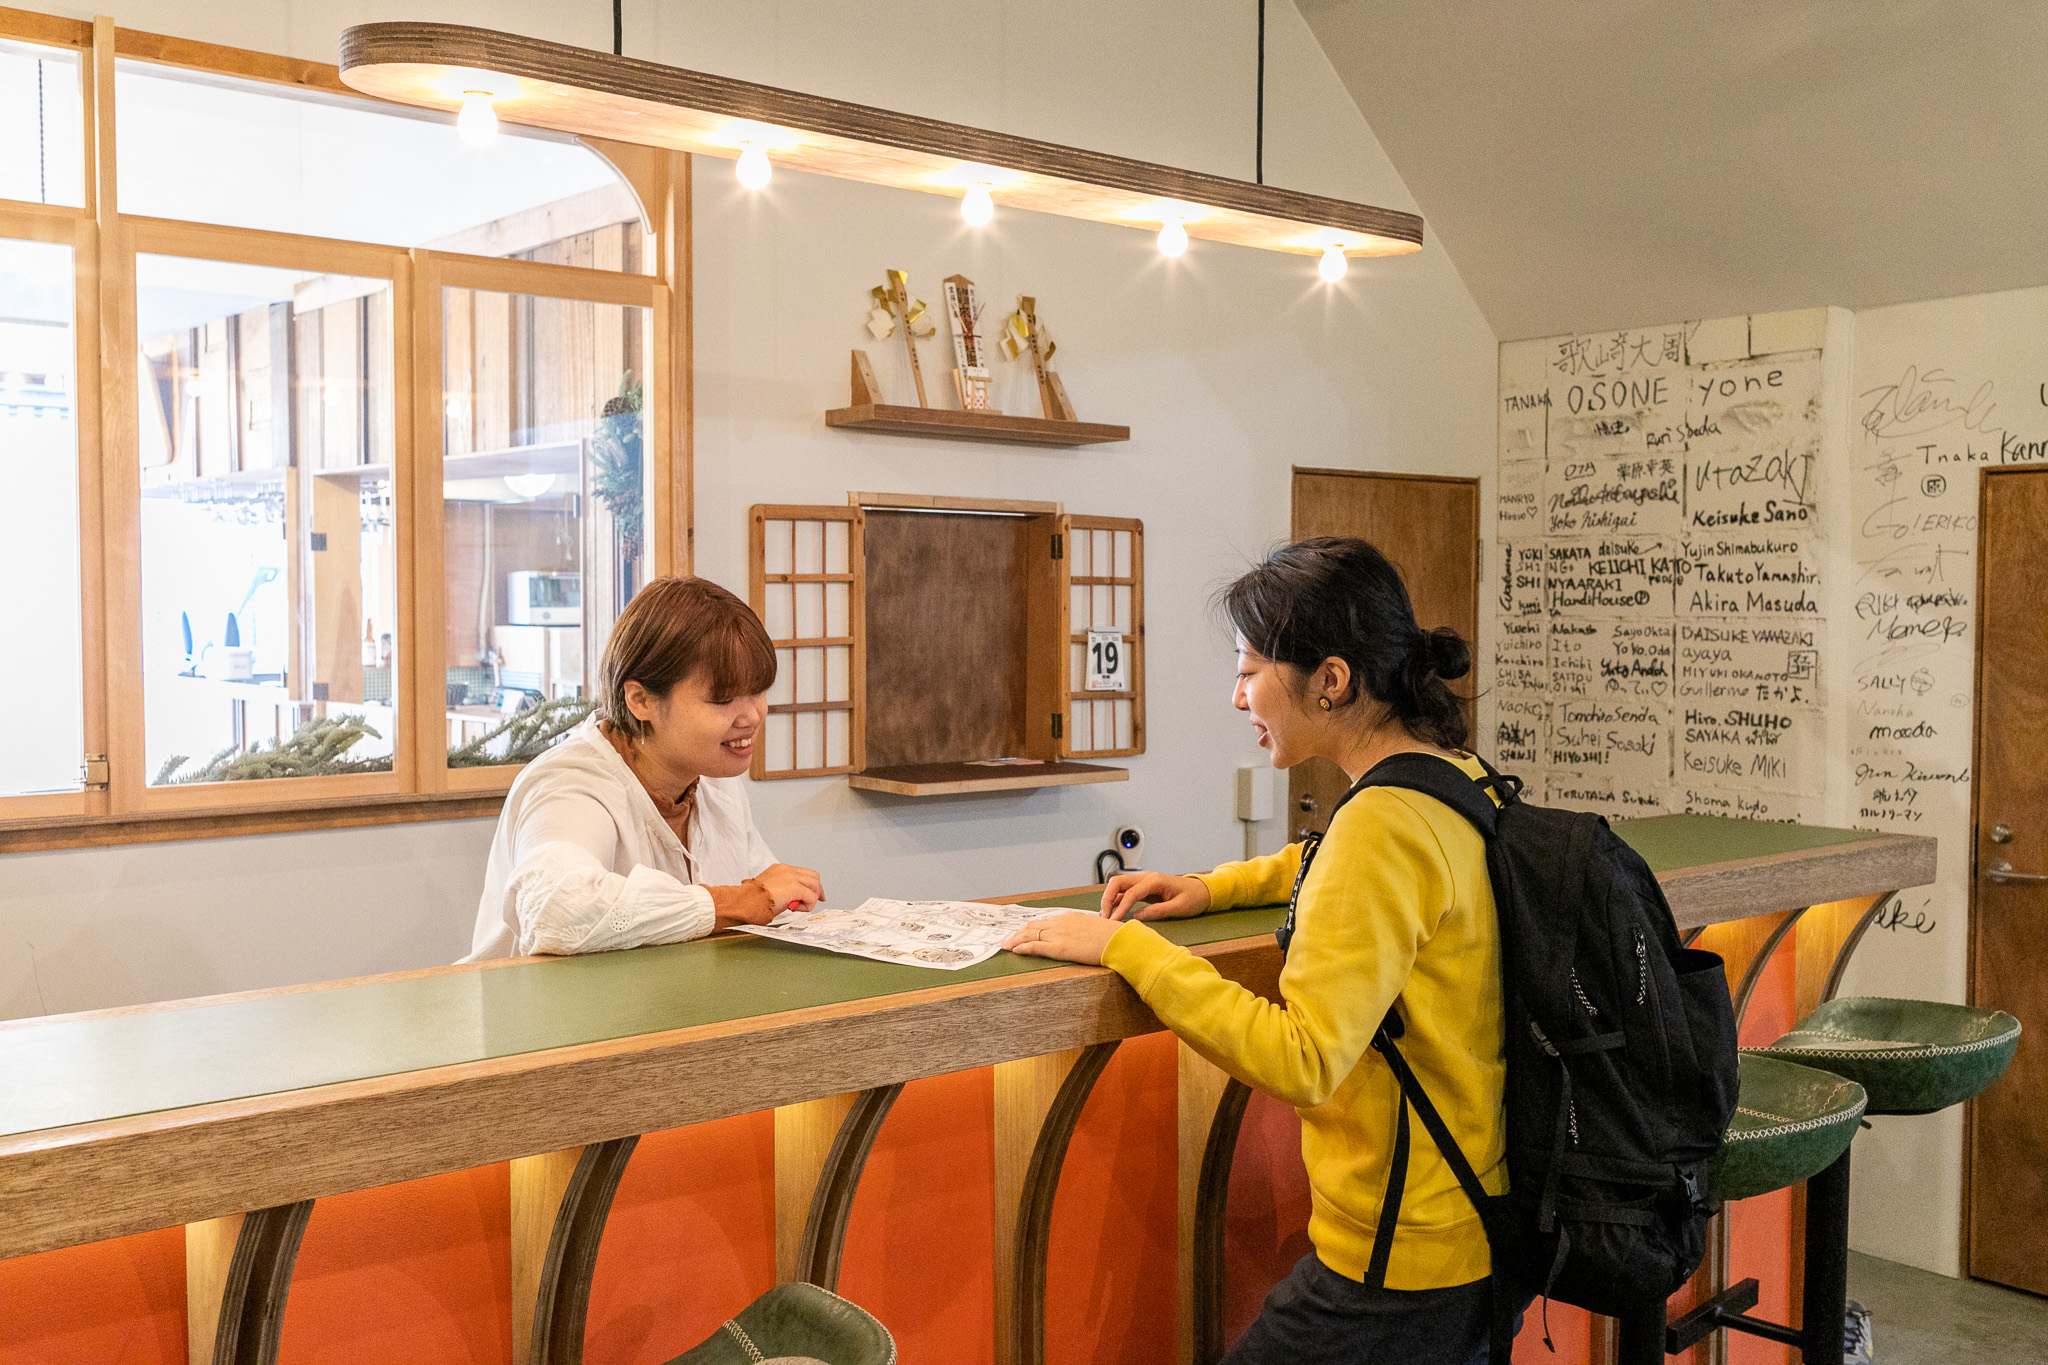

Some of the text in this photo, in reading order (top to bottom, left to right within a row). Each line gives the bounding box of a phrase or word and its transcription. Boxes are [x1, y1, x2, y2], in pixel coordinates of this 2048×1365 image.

[1692, 500, 1808, 527] Keisuke Sano
[1689, 589, 1818, 614] Akira Masuda
[1092, 641, 1119, 675] 19
